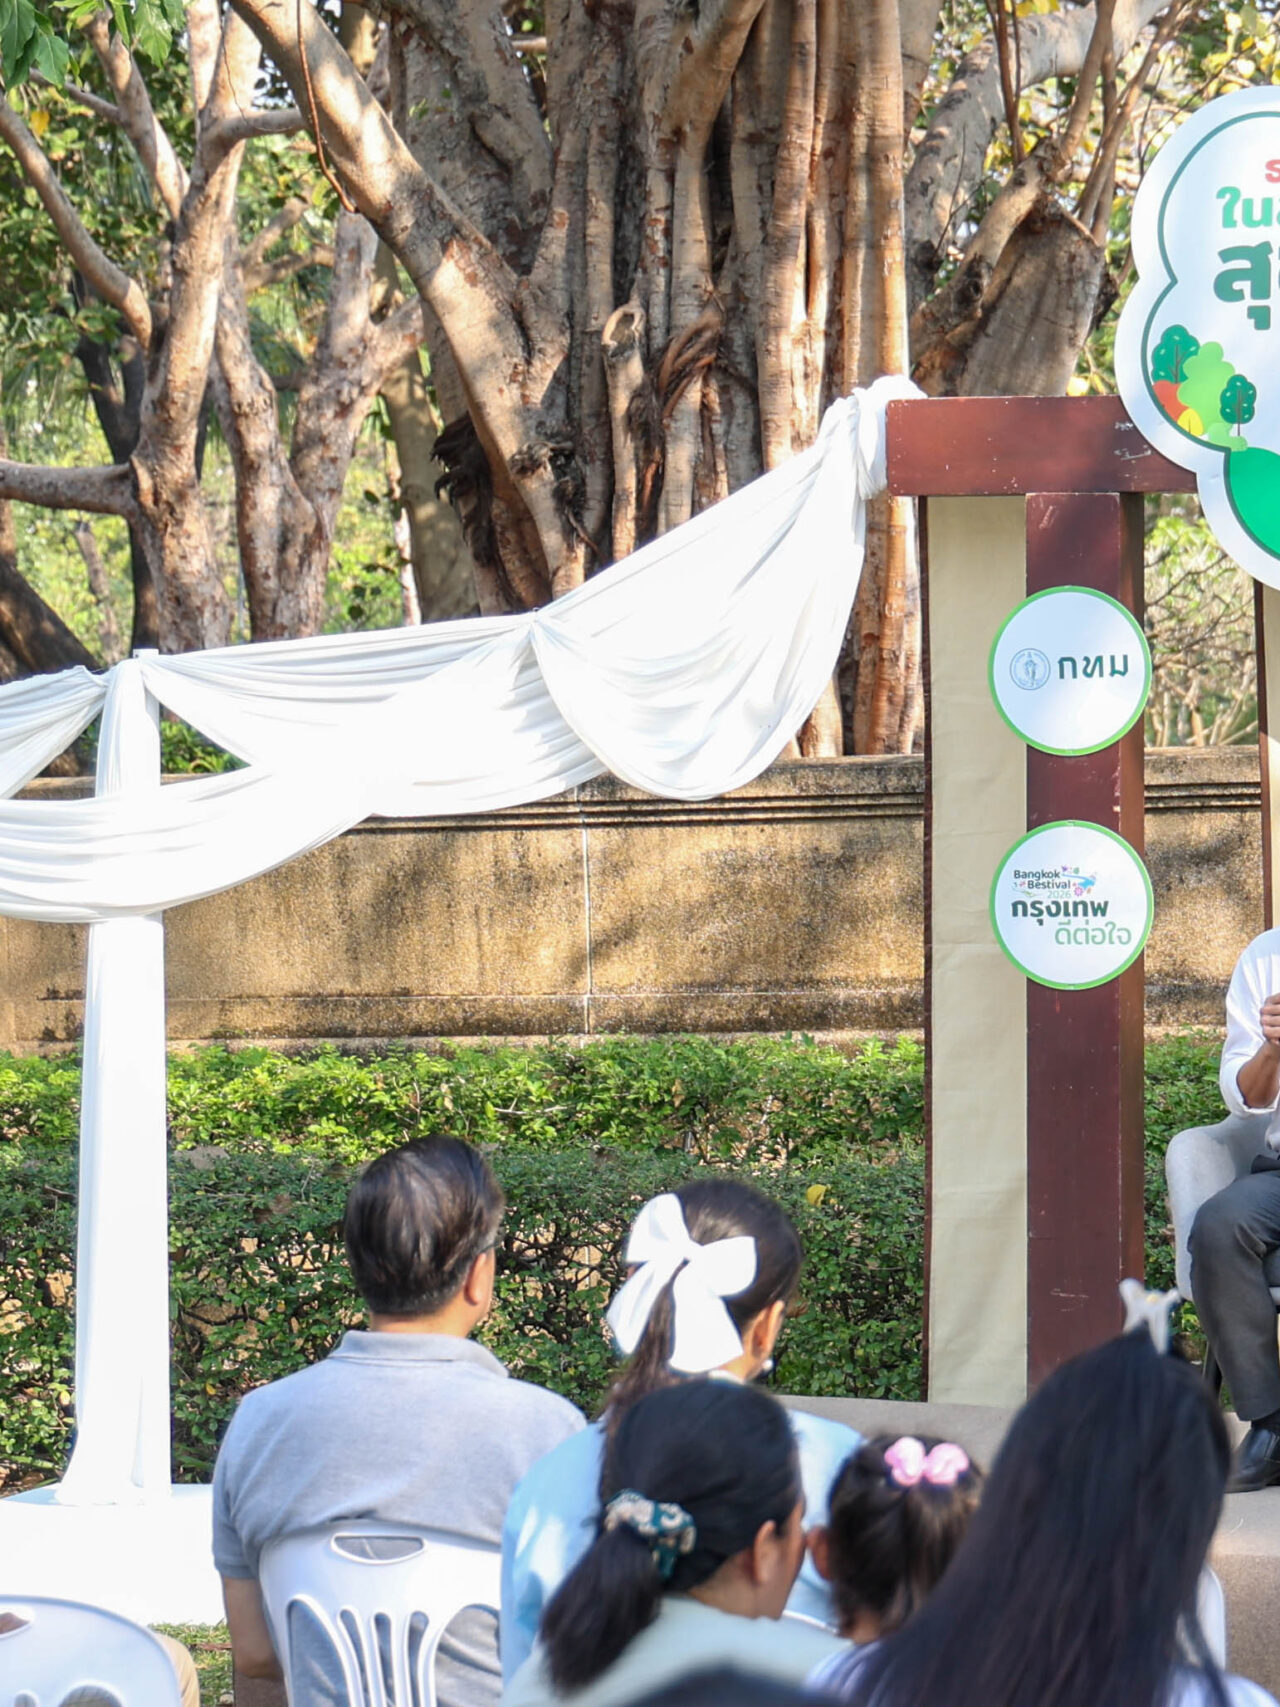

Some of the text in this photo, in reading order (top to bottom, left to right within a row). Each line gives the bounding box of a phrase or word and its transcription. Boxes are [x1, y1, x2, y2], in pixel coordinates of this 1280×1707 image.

[1058, 654, 1128, 679] กทม
[1014, 869, 1061, 881] Bangkok
[1027, 880, 1071, 890] Bestival
[1047, 890, 1072, 899] 2026
[1011, 900, 1109, 926] กรุงเทพ
[1055, 919, 1132, 945] ดีต่อใจ
